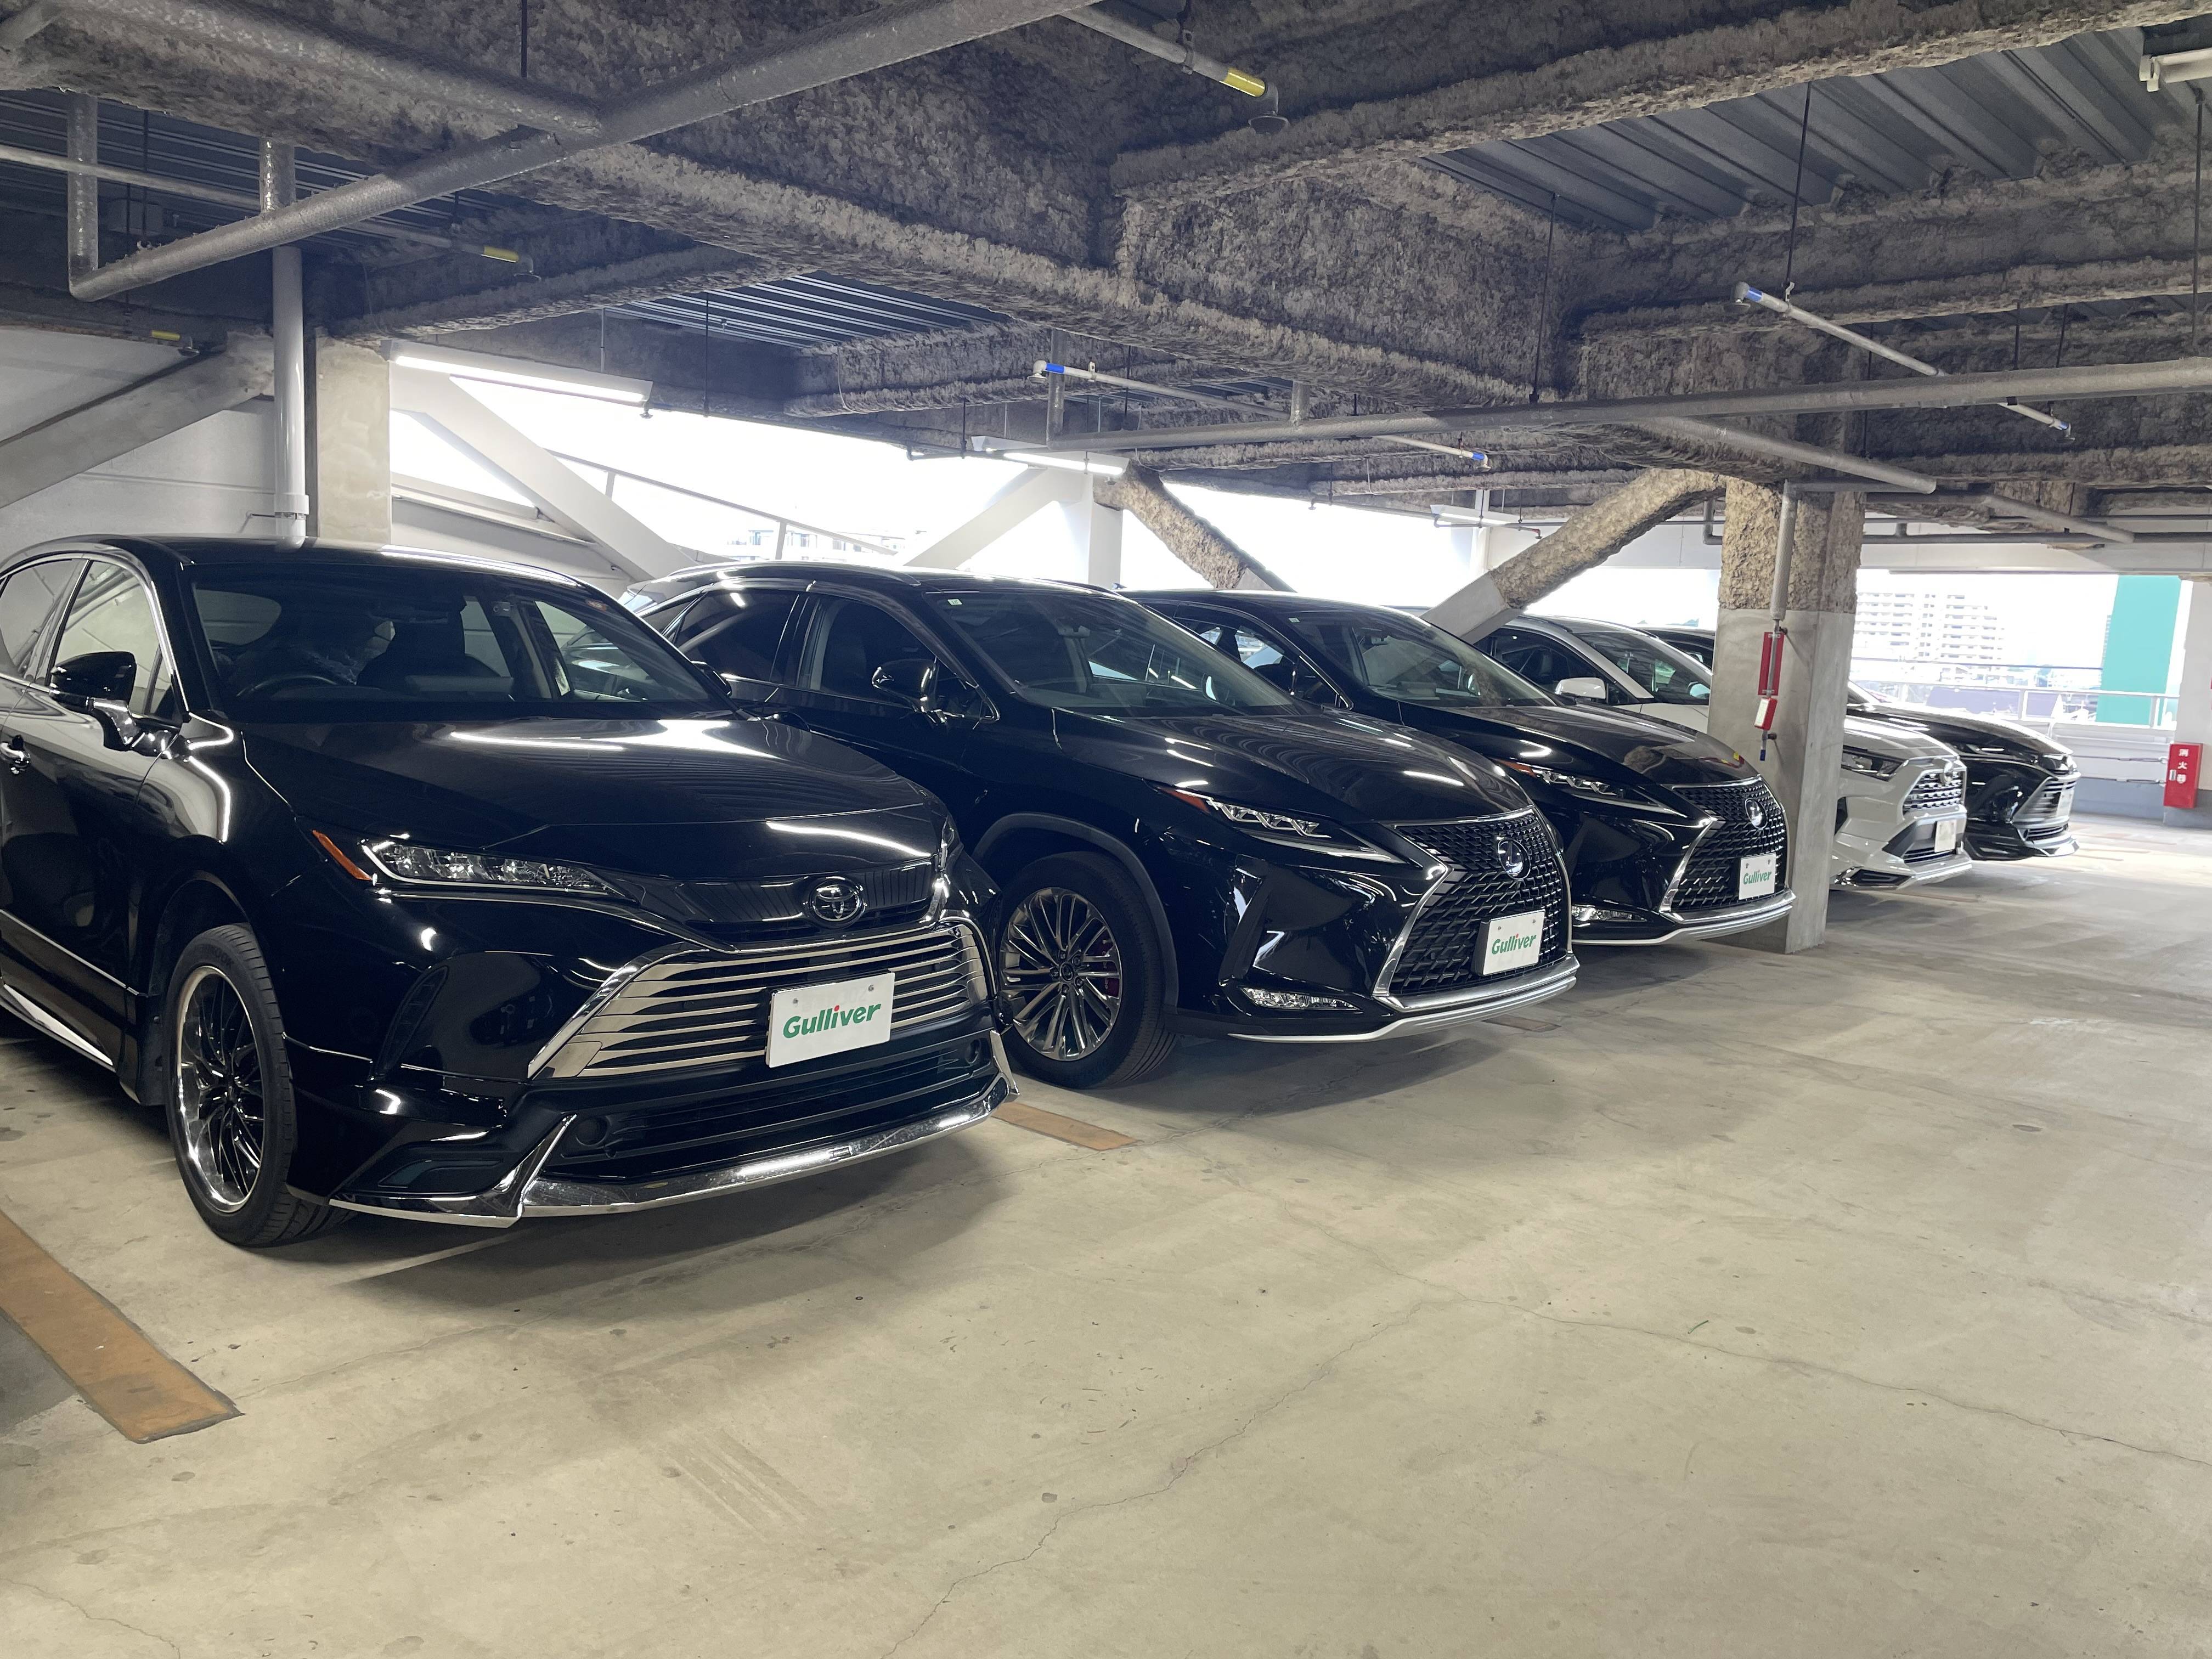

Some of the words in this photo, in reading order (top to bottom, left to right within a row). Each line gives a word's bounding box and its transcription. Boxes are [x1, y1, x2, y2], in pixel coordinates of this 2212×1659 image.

[1743, 869, 1772, 885] Gulliver
[1491, 933, 1537, 955] Gulliver
[783, 1003, 881, 1039] Gulliver
